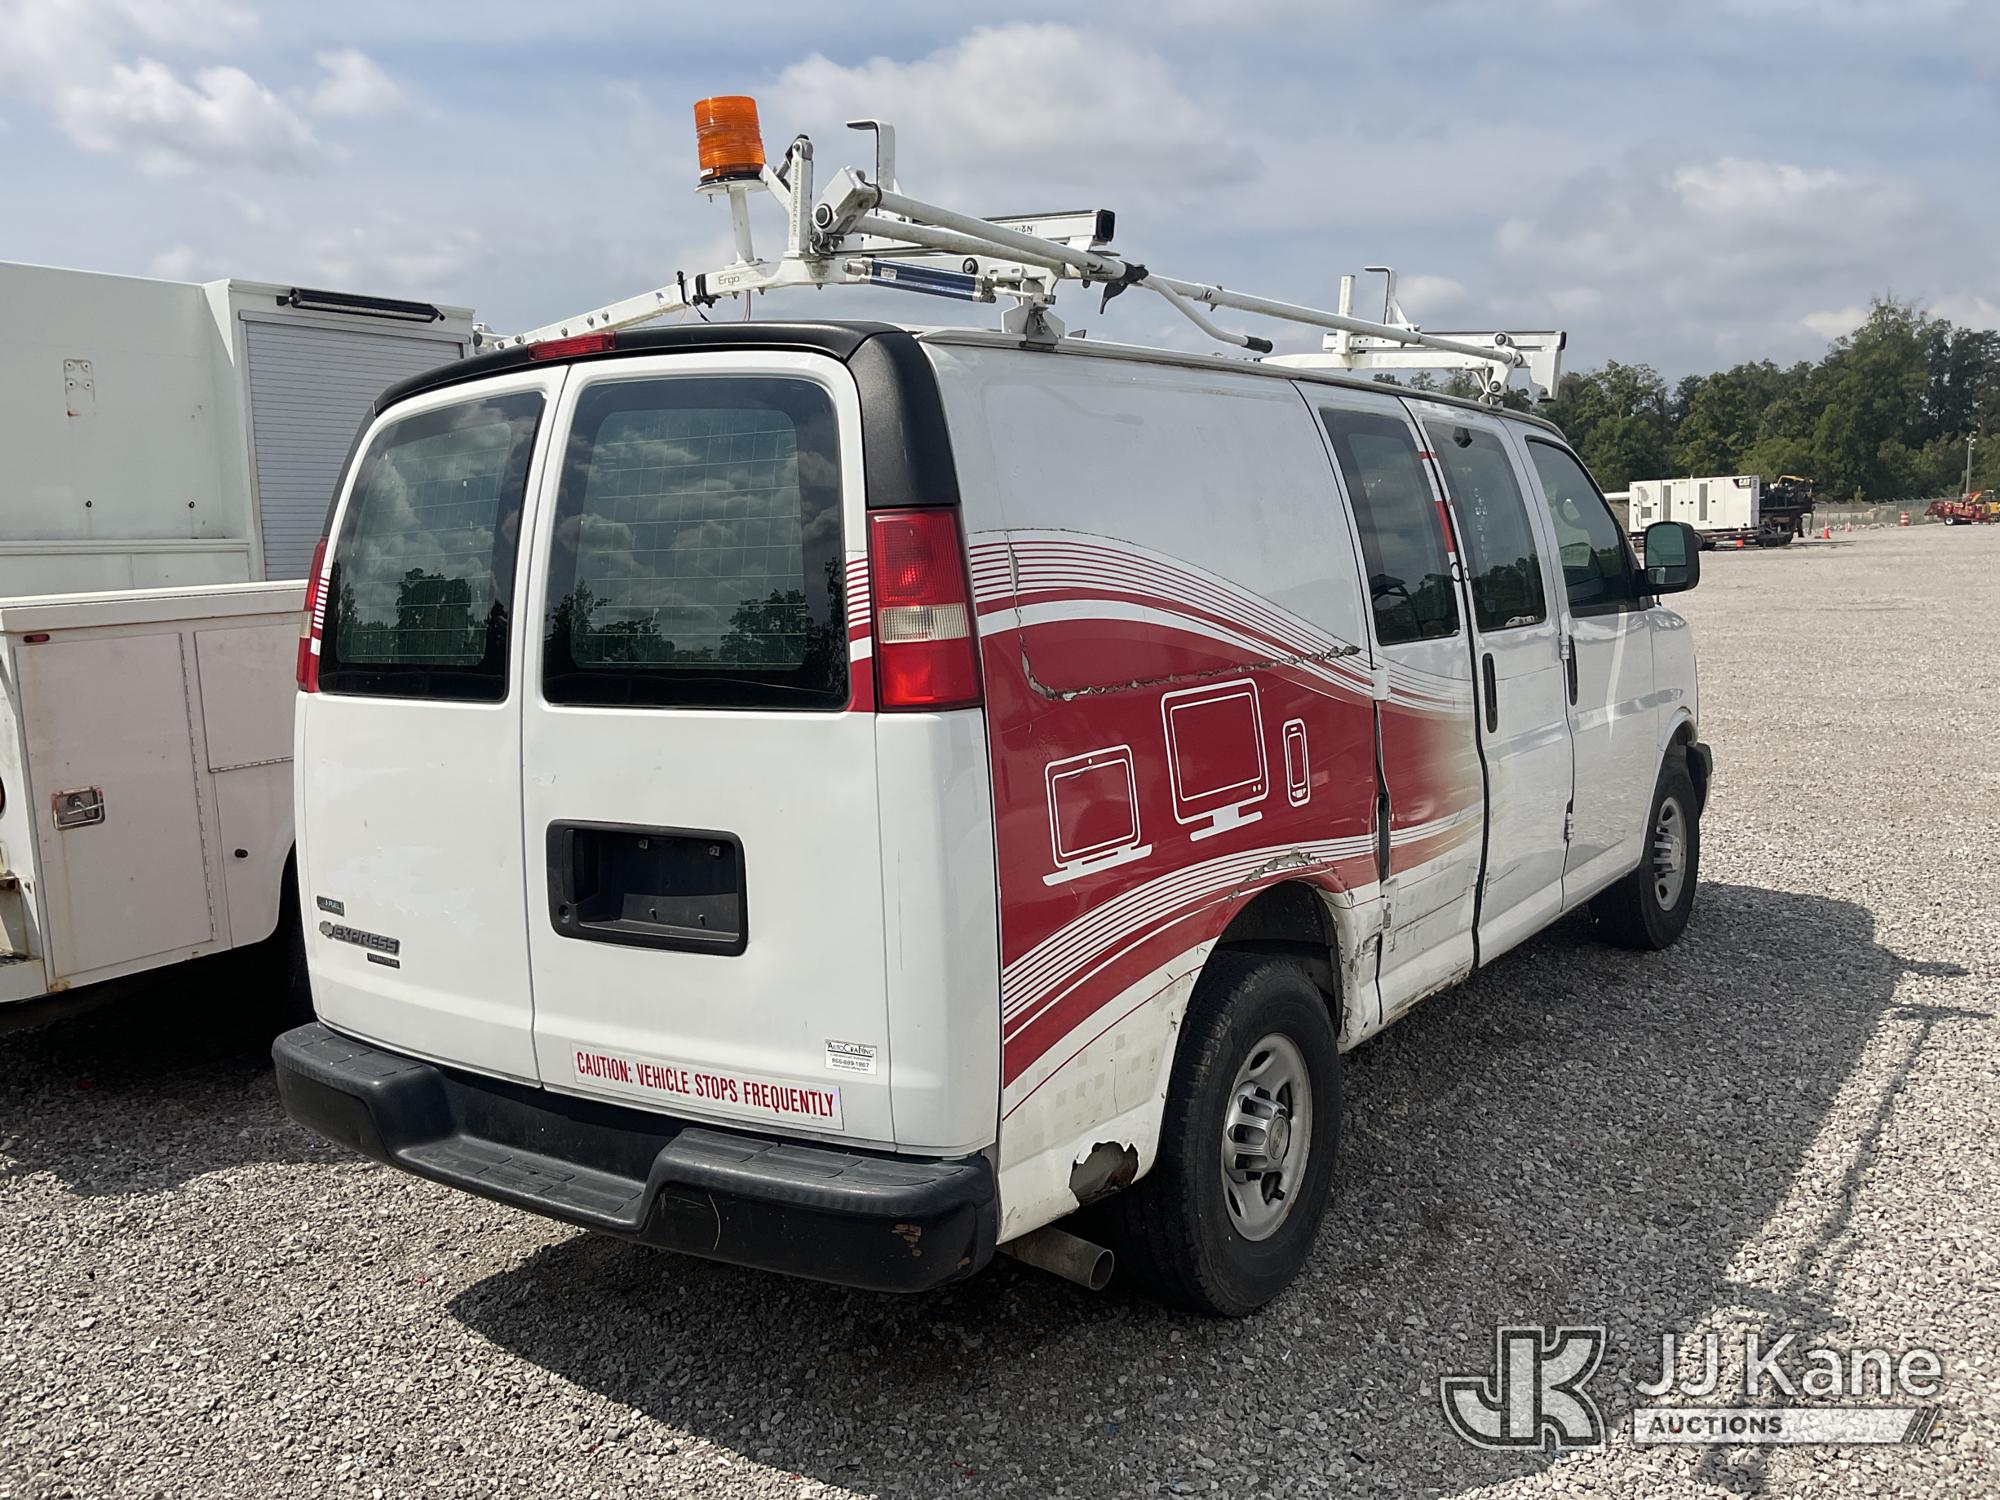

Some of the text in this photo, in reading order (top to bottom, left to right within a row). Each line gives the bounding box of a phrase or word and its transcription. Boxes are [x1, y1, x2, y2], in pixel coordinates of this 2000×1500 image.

[718, 275, 740, 286] Ergo
[576, 1051, 834, 1118] CAUTION: VEHICLE STOPS FREQUENTLY
